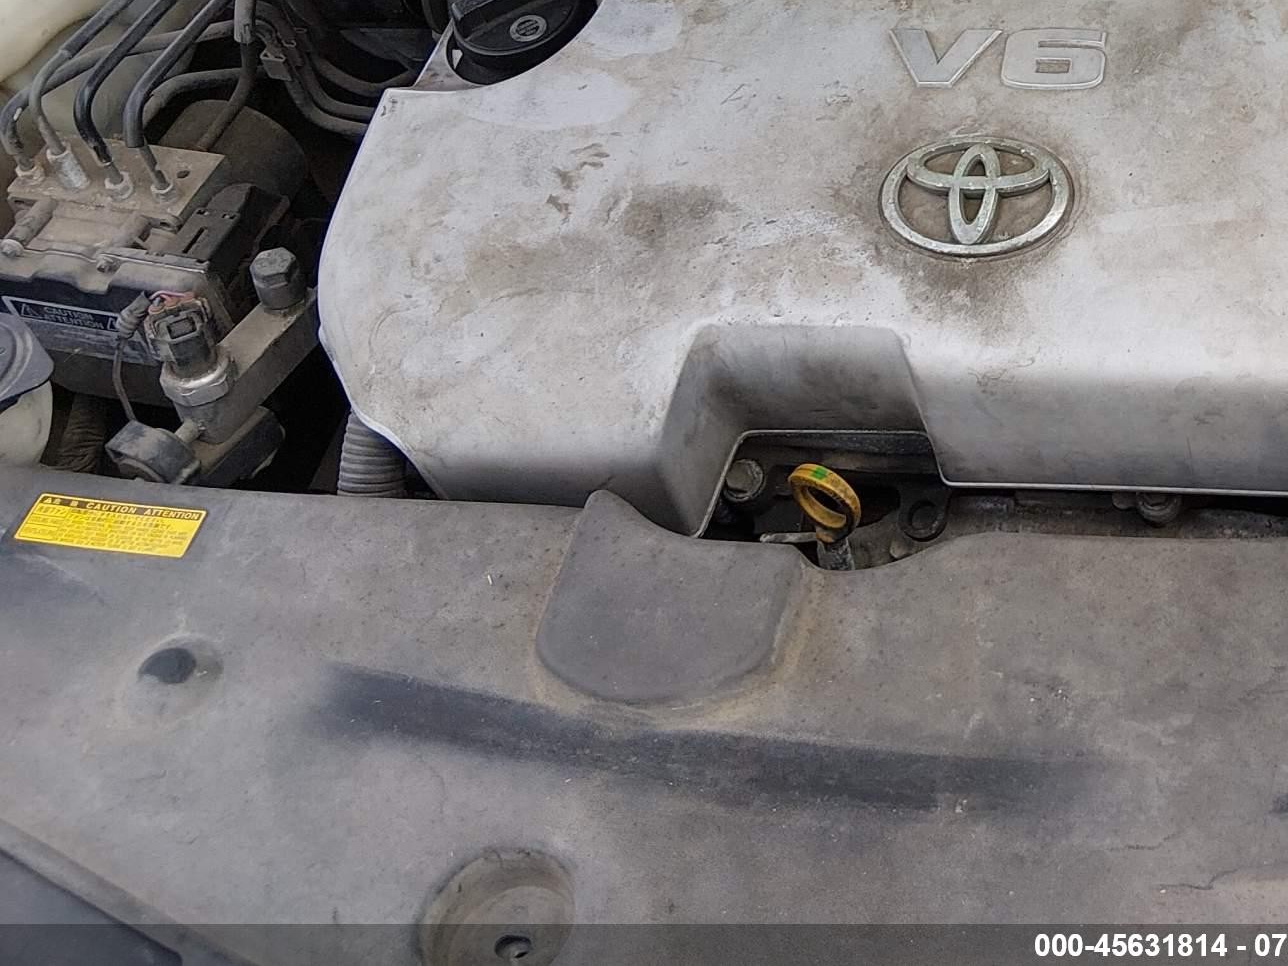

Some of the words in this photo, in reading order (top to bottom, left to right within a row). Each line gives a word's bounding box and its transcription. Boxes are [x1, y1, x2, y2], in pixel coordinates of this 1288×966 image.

[888, 27, 1107, 91] V6
[86, 501, 137, 515] CAUTION
[144, 507, 199, 521] ATTENTION
